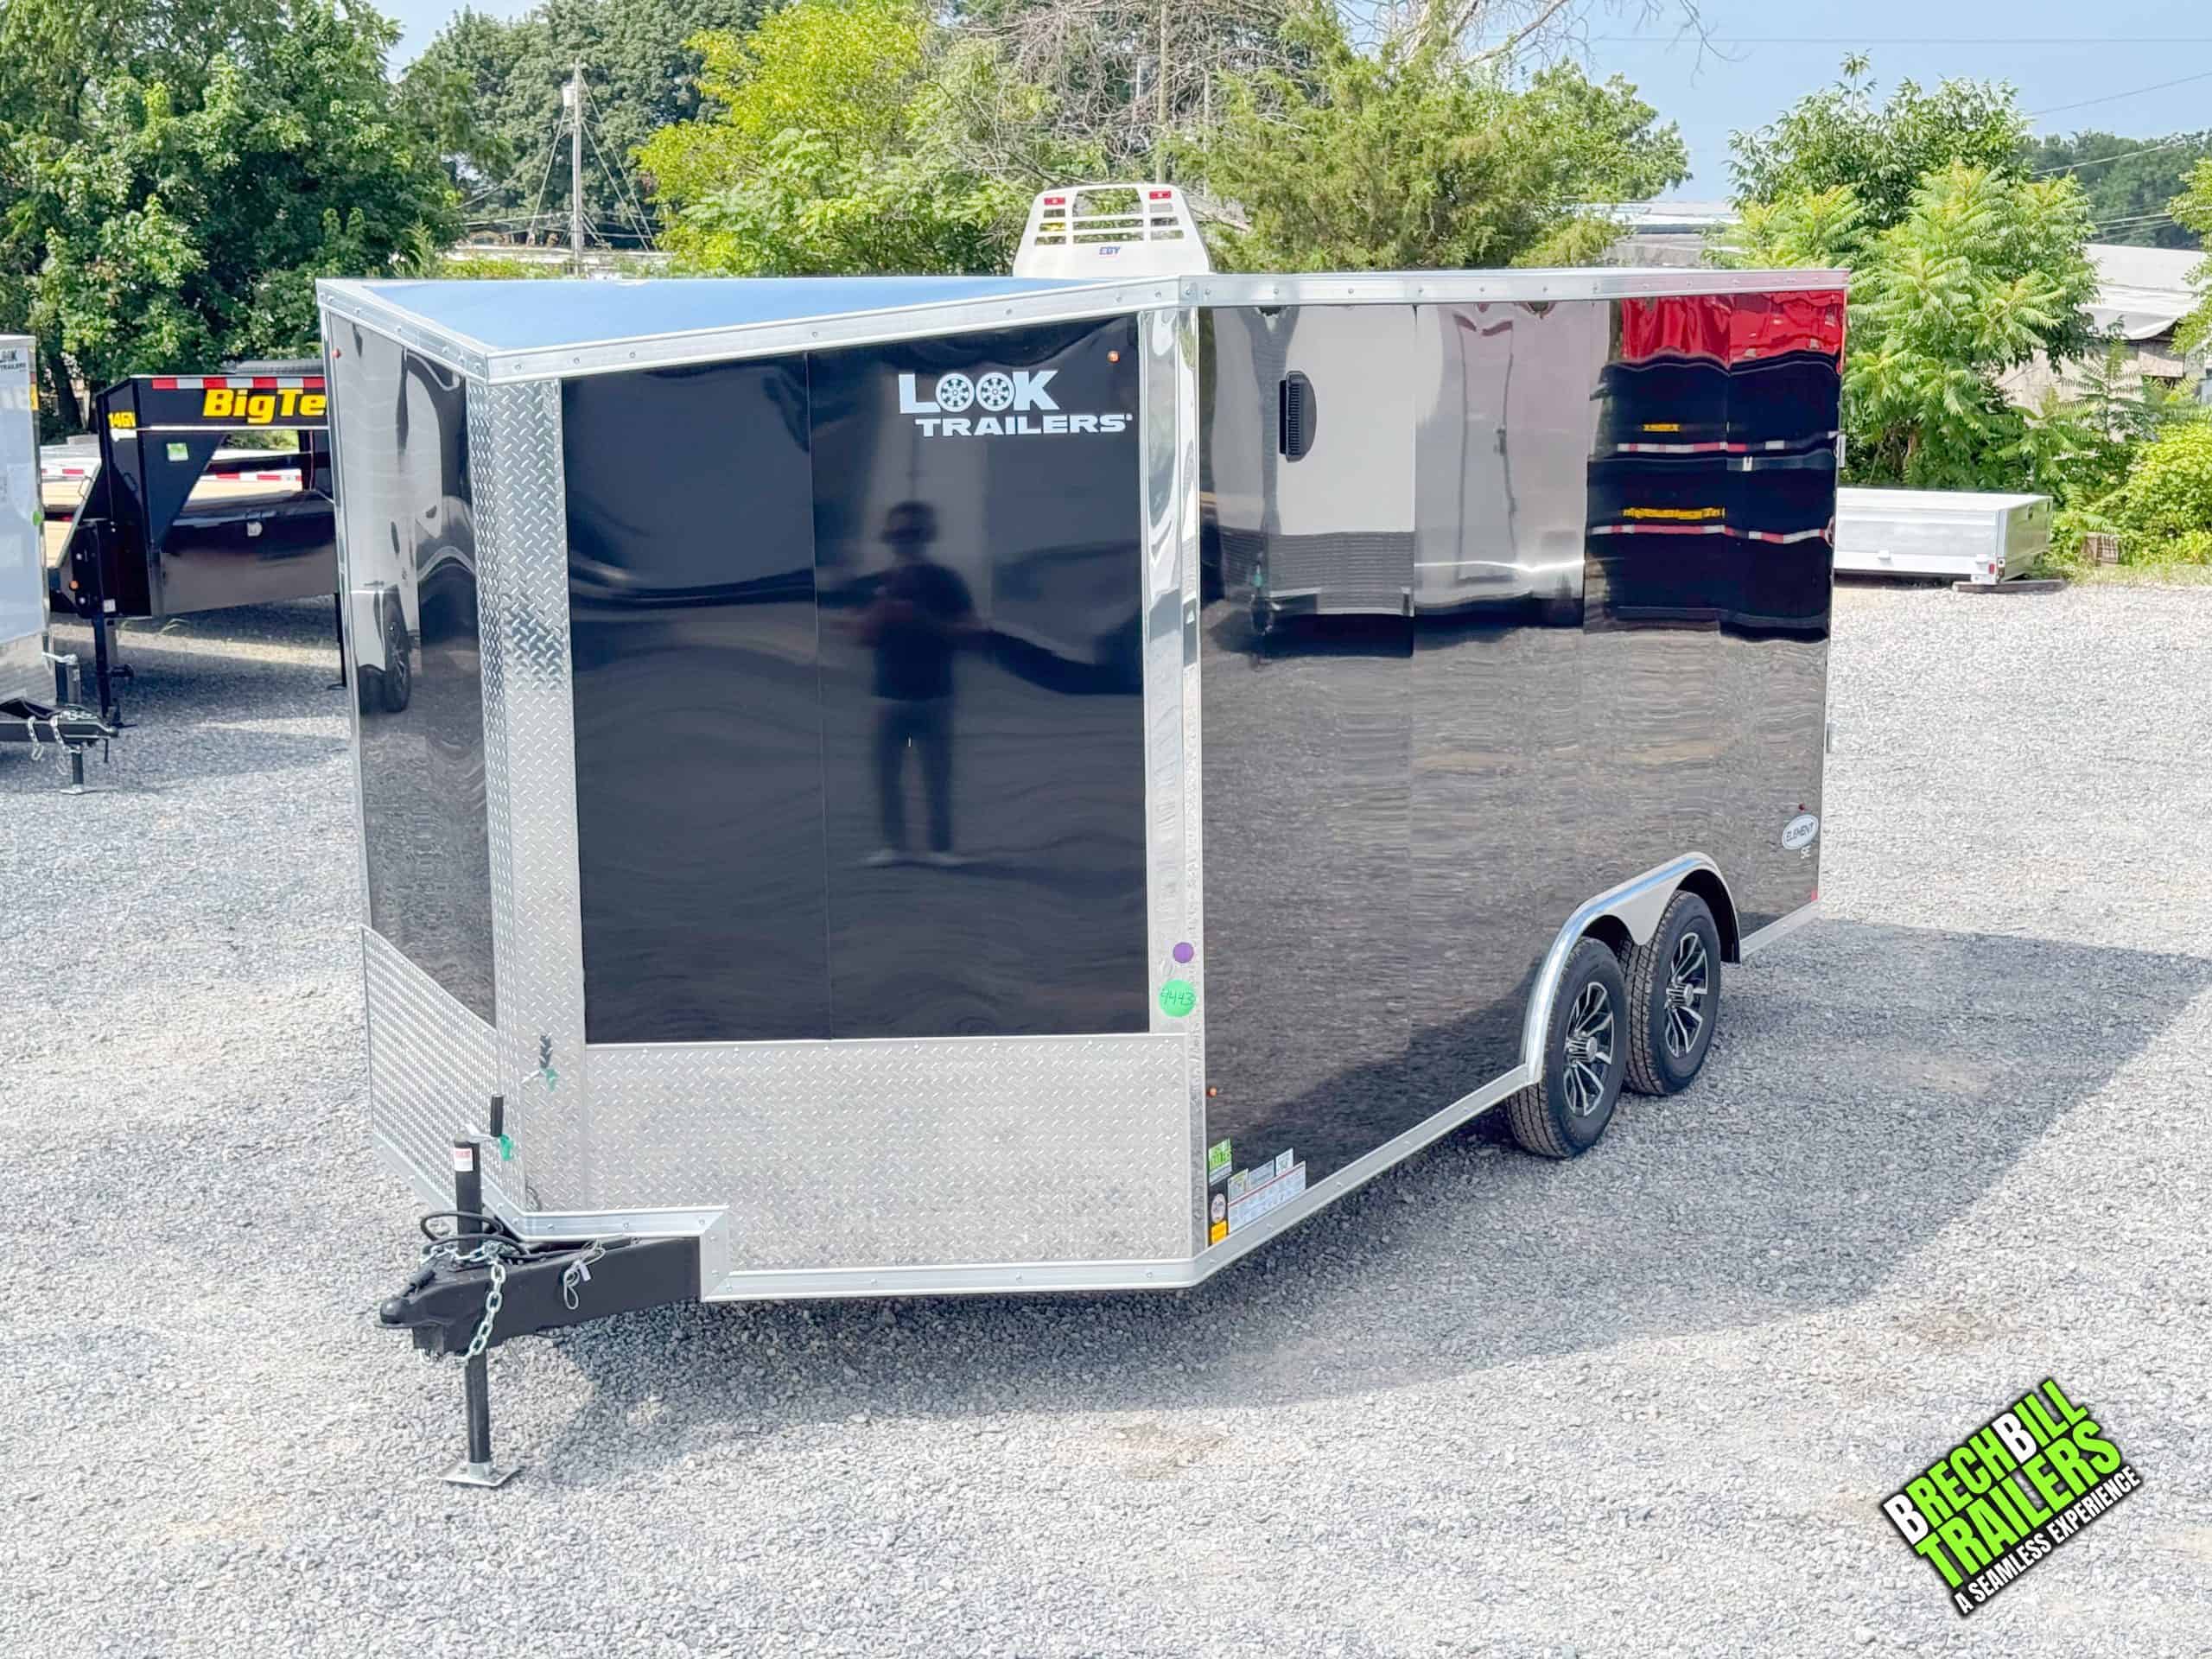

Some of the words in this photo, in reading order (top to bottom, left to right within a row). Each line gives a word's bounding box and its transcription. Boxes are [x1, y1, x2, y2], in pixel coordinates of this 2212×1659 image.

[202, 388, 327, 424] BigTe
[898, 370, 1060, 415] LOOK
[914, 414, 1128, 437] TRAILERS
[1785, 821, 1815, 842] ELEMENT
